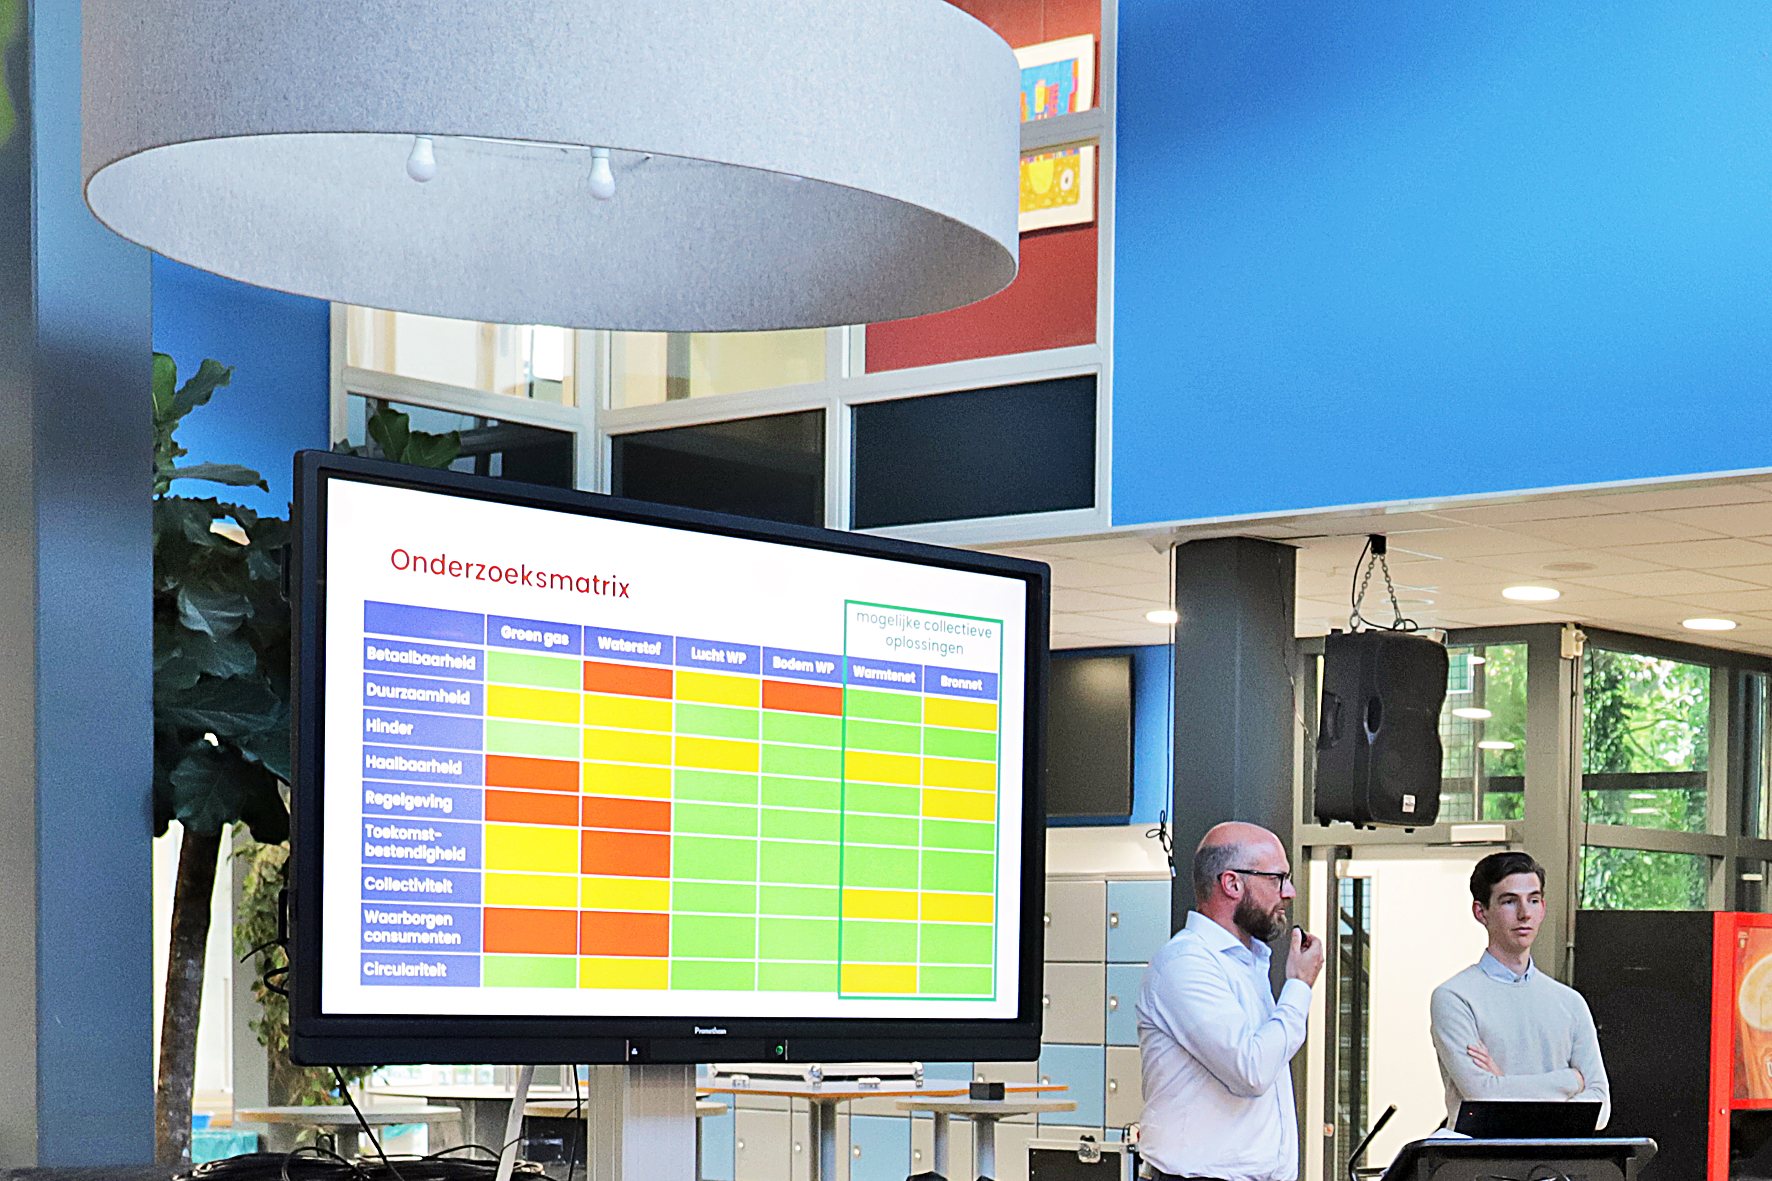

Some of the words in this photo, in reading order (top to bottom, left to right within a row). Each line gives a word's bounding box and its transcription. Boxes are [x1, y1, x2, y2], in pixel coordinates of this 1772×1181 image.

[391, 549, 629, 598] Onderzoeksmatrix
[857, 611, 921, 631] mogelijke
[924, 619, 992, 638] collectieve
[501, 625, 542, 642] Groen
[544, 631, 569, 647] gas
[598, 636, 661, 655] Waterstof
[691, 647, 725, 663] Lucht
[726, 651, 747, 664] WP
[886, 636, 964, 656] oplossingen
[367, 646, 476, 670] Betaalbaarheid
[773, 656, 813, 673] Bodem
[815, 660, 835, 674] WP
[853, 665, 916, 684] Warmtenet
[940, 675, 983, 691] Bronnet
[366, 682, 470, 705] Duurzaamheid
[366, 718, 414, 735] Hinder
[366, 754, 462, 775] Haalbaarheid
[365, 790, 452, 813] Regelgeving
[365, 824, 442, 842] Toekomst-
[365, 842, 466, 863] bestendigheid
[364, 877, 453, 893] Collectiviteit
[364, 909, 453, 929] Waarborgen
[364, 929, 461, 945] consumenten
[363, 962, 447, 977] Circulariteit
